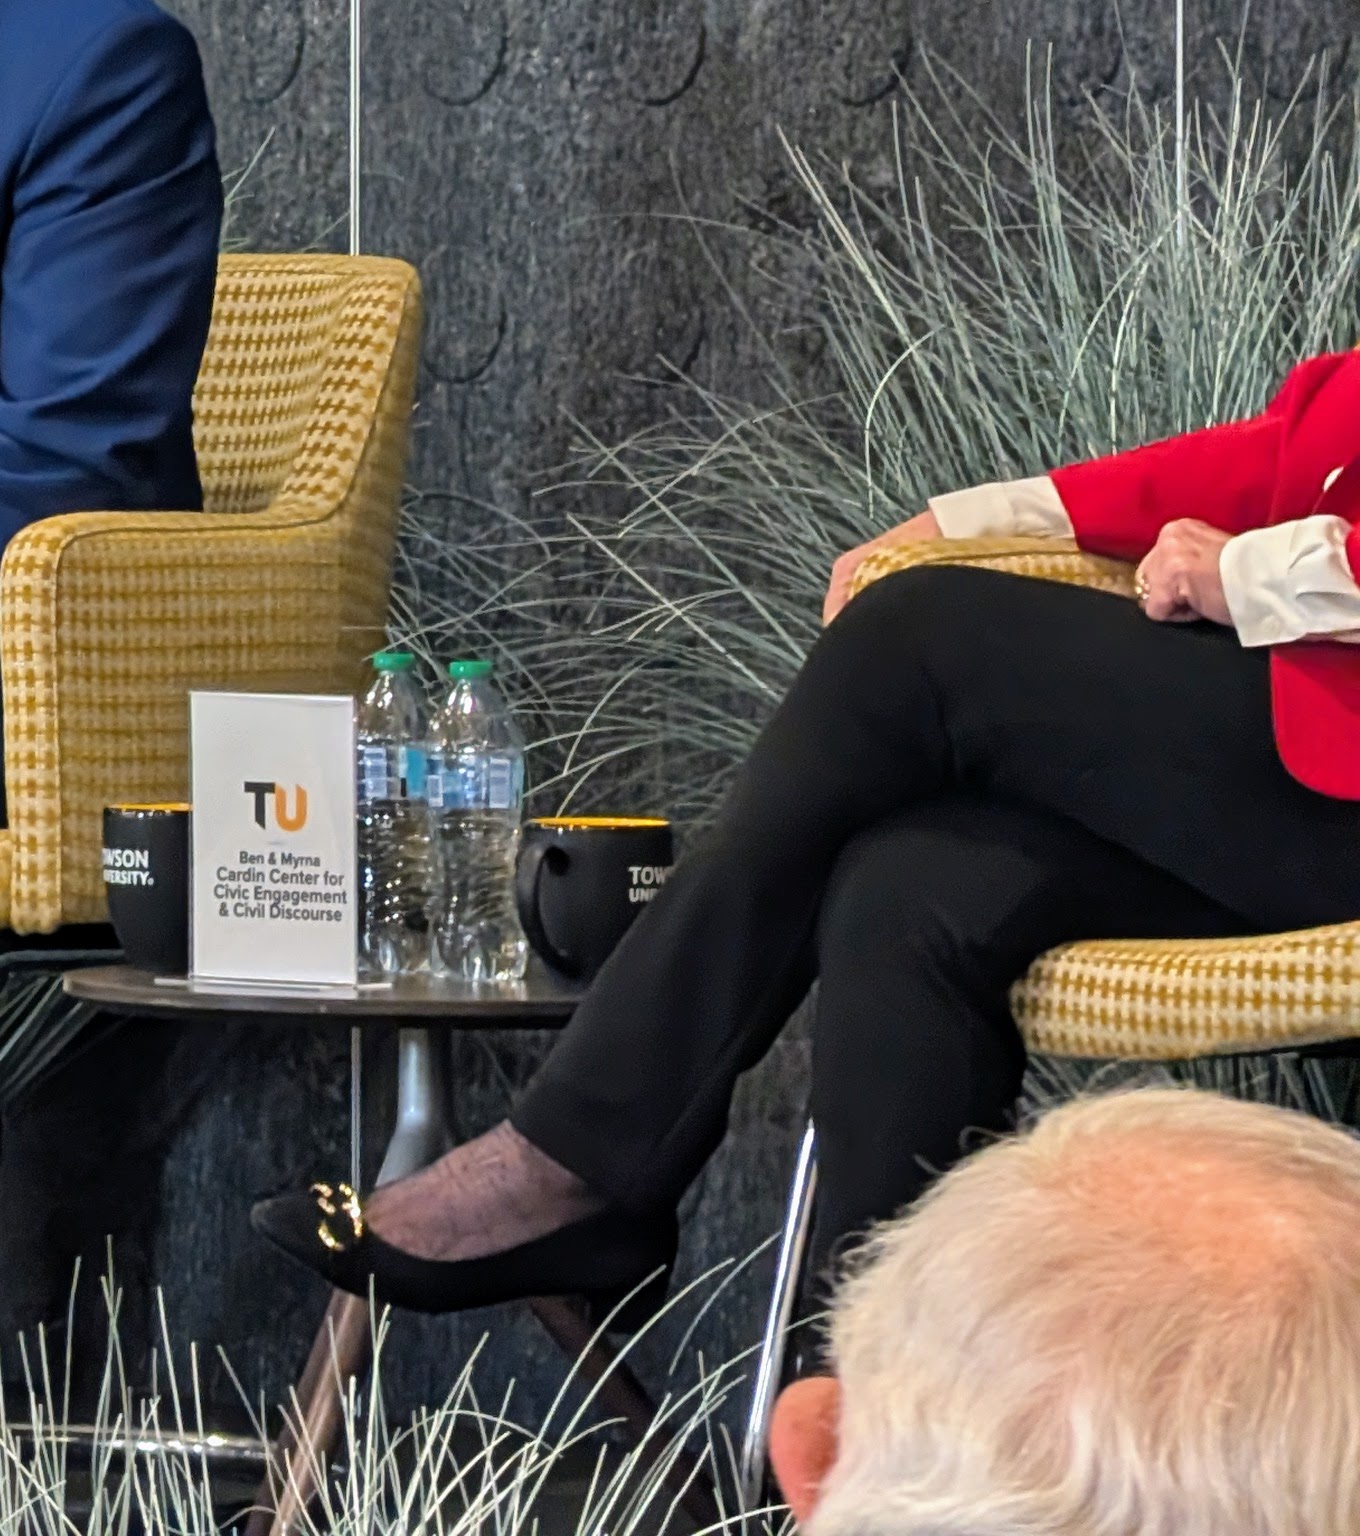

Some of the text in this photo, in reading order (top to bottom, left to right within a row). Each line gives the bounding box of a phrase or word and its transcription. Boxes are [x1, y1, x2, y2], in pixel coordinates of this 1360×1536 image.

[244, 781, 308, 832] TU
[239, 851, 321, 869] Ben & Myrna
[216, 866, 345, 886] Cardin Center for
[214, 883, 347, 905] Civic Engagement
[219, 902, 343, 922] & Civil Discourse
